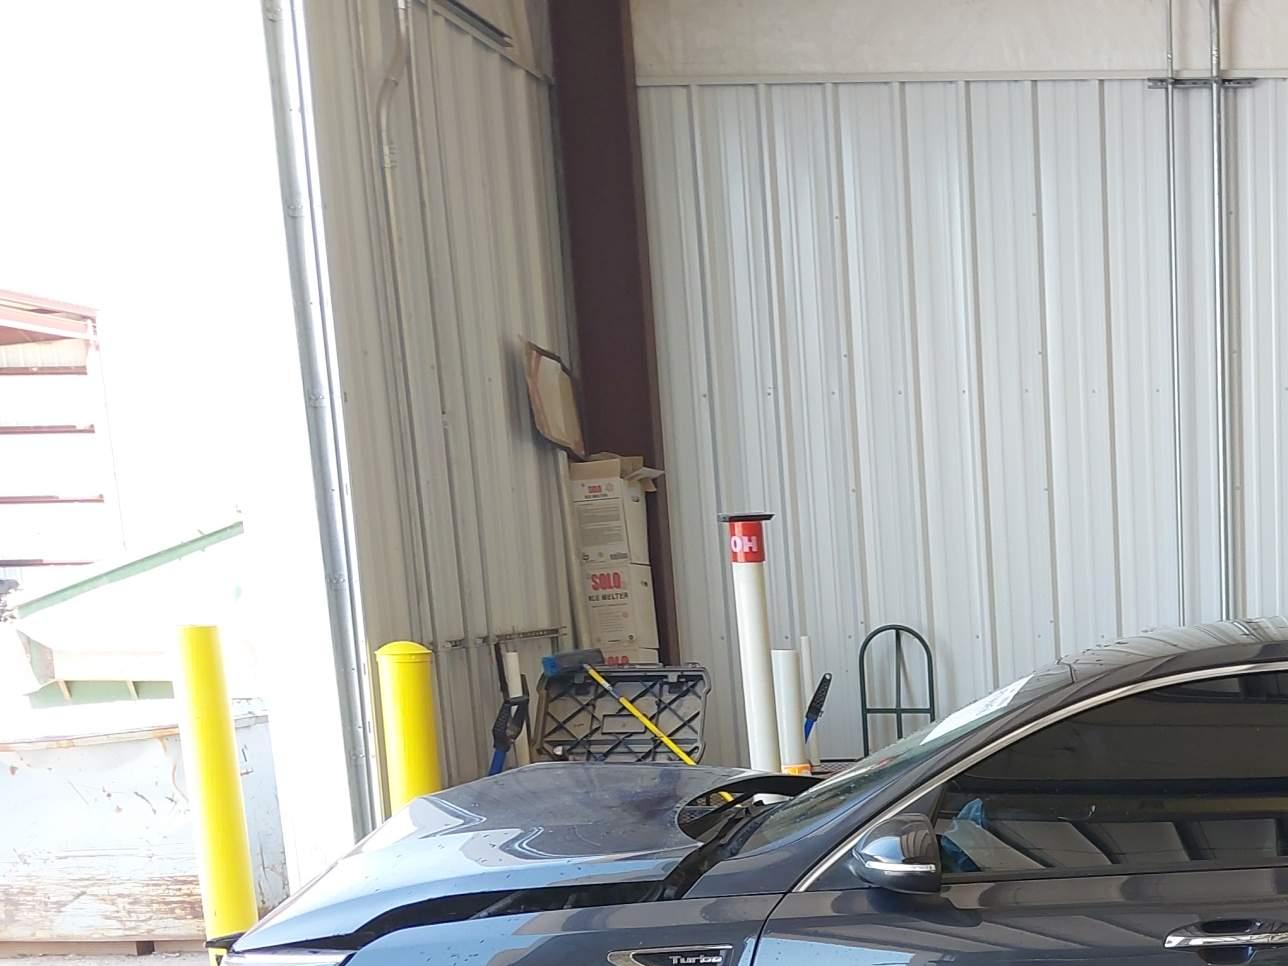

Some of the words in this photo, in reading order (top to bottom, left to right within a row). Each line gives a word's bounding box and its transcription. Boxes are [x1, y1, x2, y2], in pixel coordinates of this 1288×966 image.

[591, 572, 622, 591] SOLO
[601, 592, 628, 601] MELTER
[669, 954, 723, 965] Turbo
